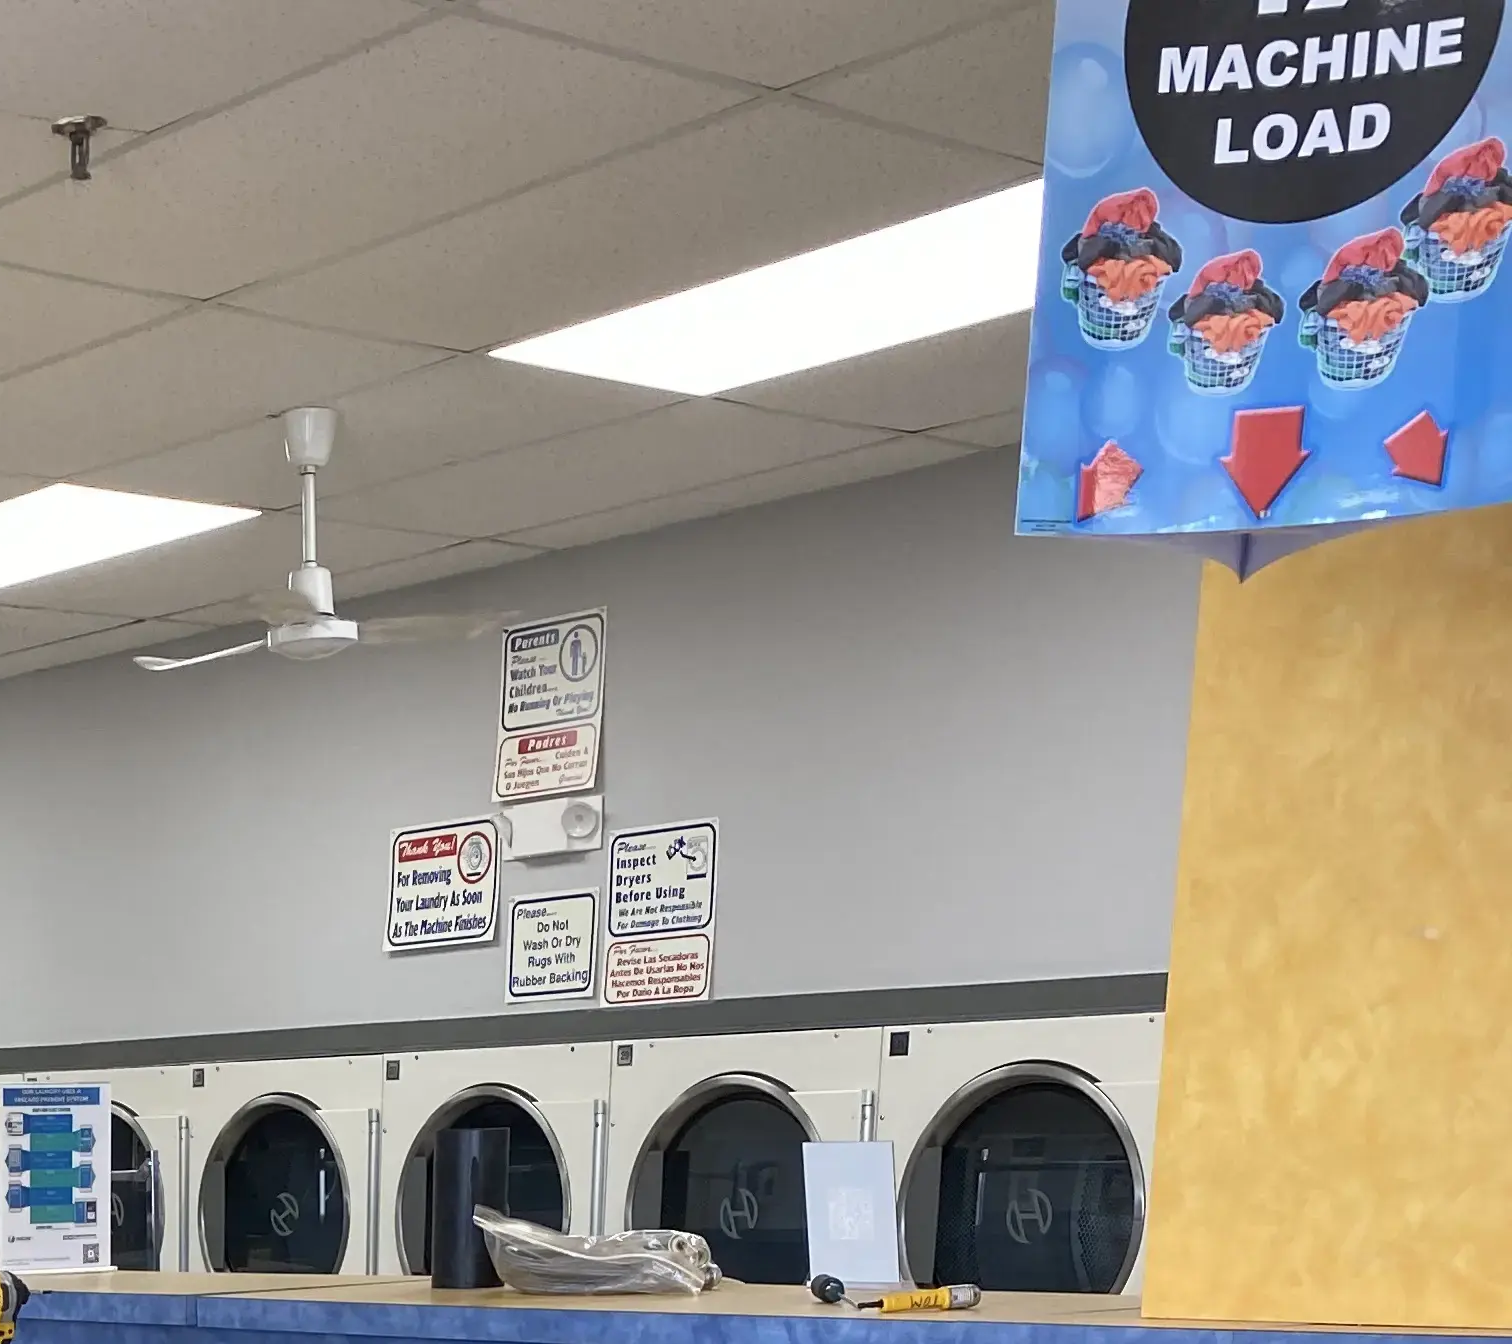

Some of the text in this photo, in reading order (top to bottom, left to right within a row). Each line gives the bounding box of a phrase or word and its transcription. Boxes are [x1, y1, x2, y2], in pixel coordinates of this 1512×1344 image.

[1156, 16, 1465, 94] MACHINE
[1213, 103, 1391, 166] LOAD
[514, 632, 556, 651] Parents
[510, 667, 536, 681] Watch
[508, 703, 519, 714] No
[552, 696, 562, 706] Or
[527, 735, 567, 751] Padres
[400, 840, 429, 857] Thank
[616, 854, 657, 870] Inspect
[397, 866, 452, 888] For Removing
[616, 873, 652, 888] Dryers
[396, 889, 483, 913] Your Laundry As Soon
[616, 885, 685, 904] Before Using
[619, 900, 703, 917] We Are Not Responsible
[392, 913, 486, 938] As The Machine Finishes
[537, 919, 569, 933] Do Not
[616, 914, 702, 930] For Damage To Clothing
[523, 935, 581, 951] Wash Or Dry
[528, 952, 576, 969] Rugs With
[617, 952, 698, 967] Revise Las Secadoras
[512, 968, 588, 987] Rubber Backing
[610, 969, 631, 978] Antes
[633, 967, 644, 976] De
[676, 963, 687, 972] No
[689, 962, 704, 970] Nos
[612, 973, 701, 988] Hacemos Responsables
[616, 990, 630, 998] Por
[654, 986, 660, 995] A
[662, 985, 671, 994] La
[673, 985, 694, 995] Ropa
